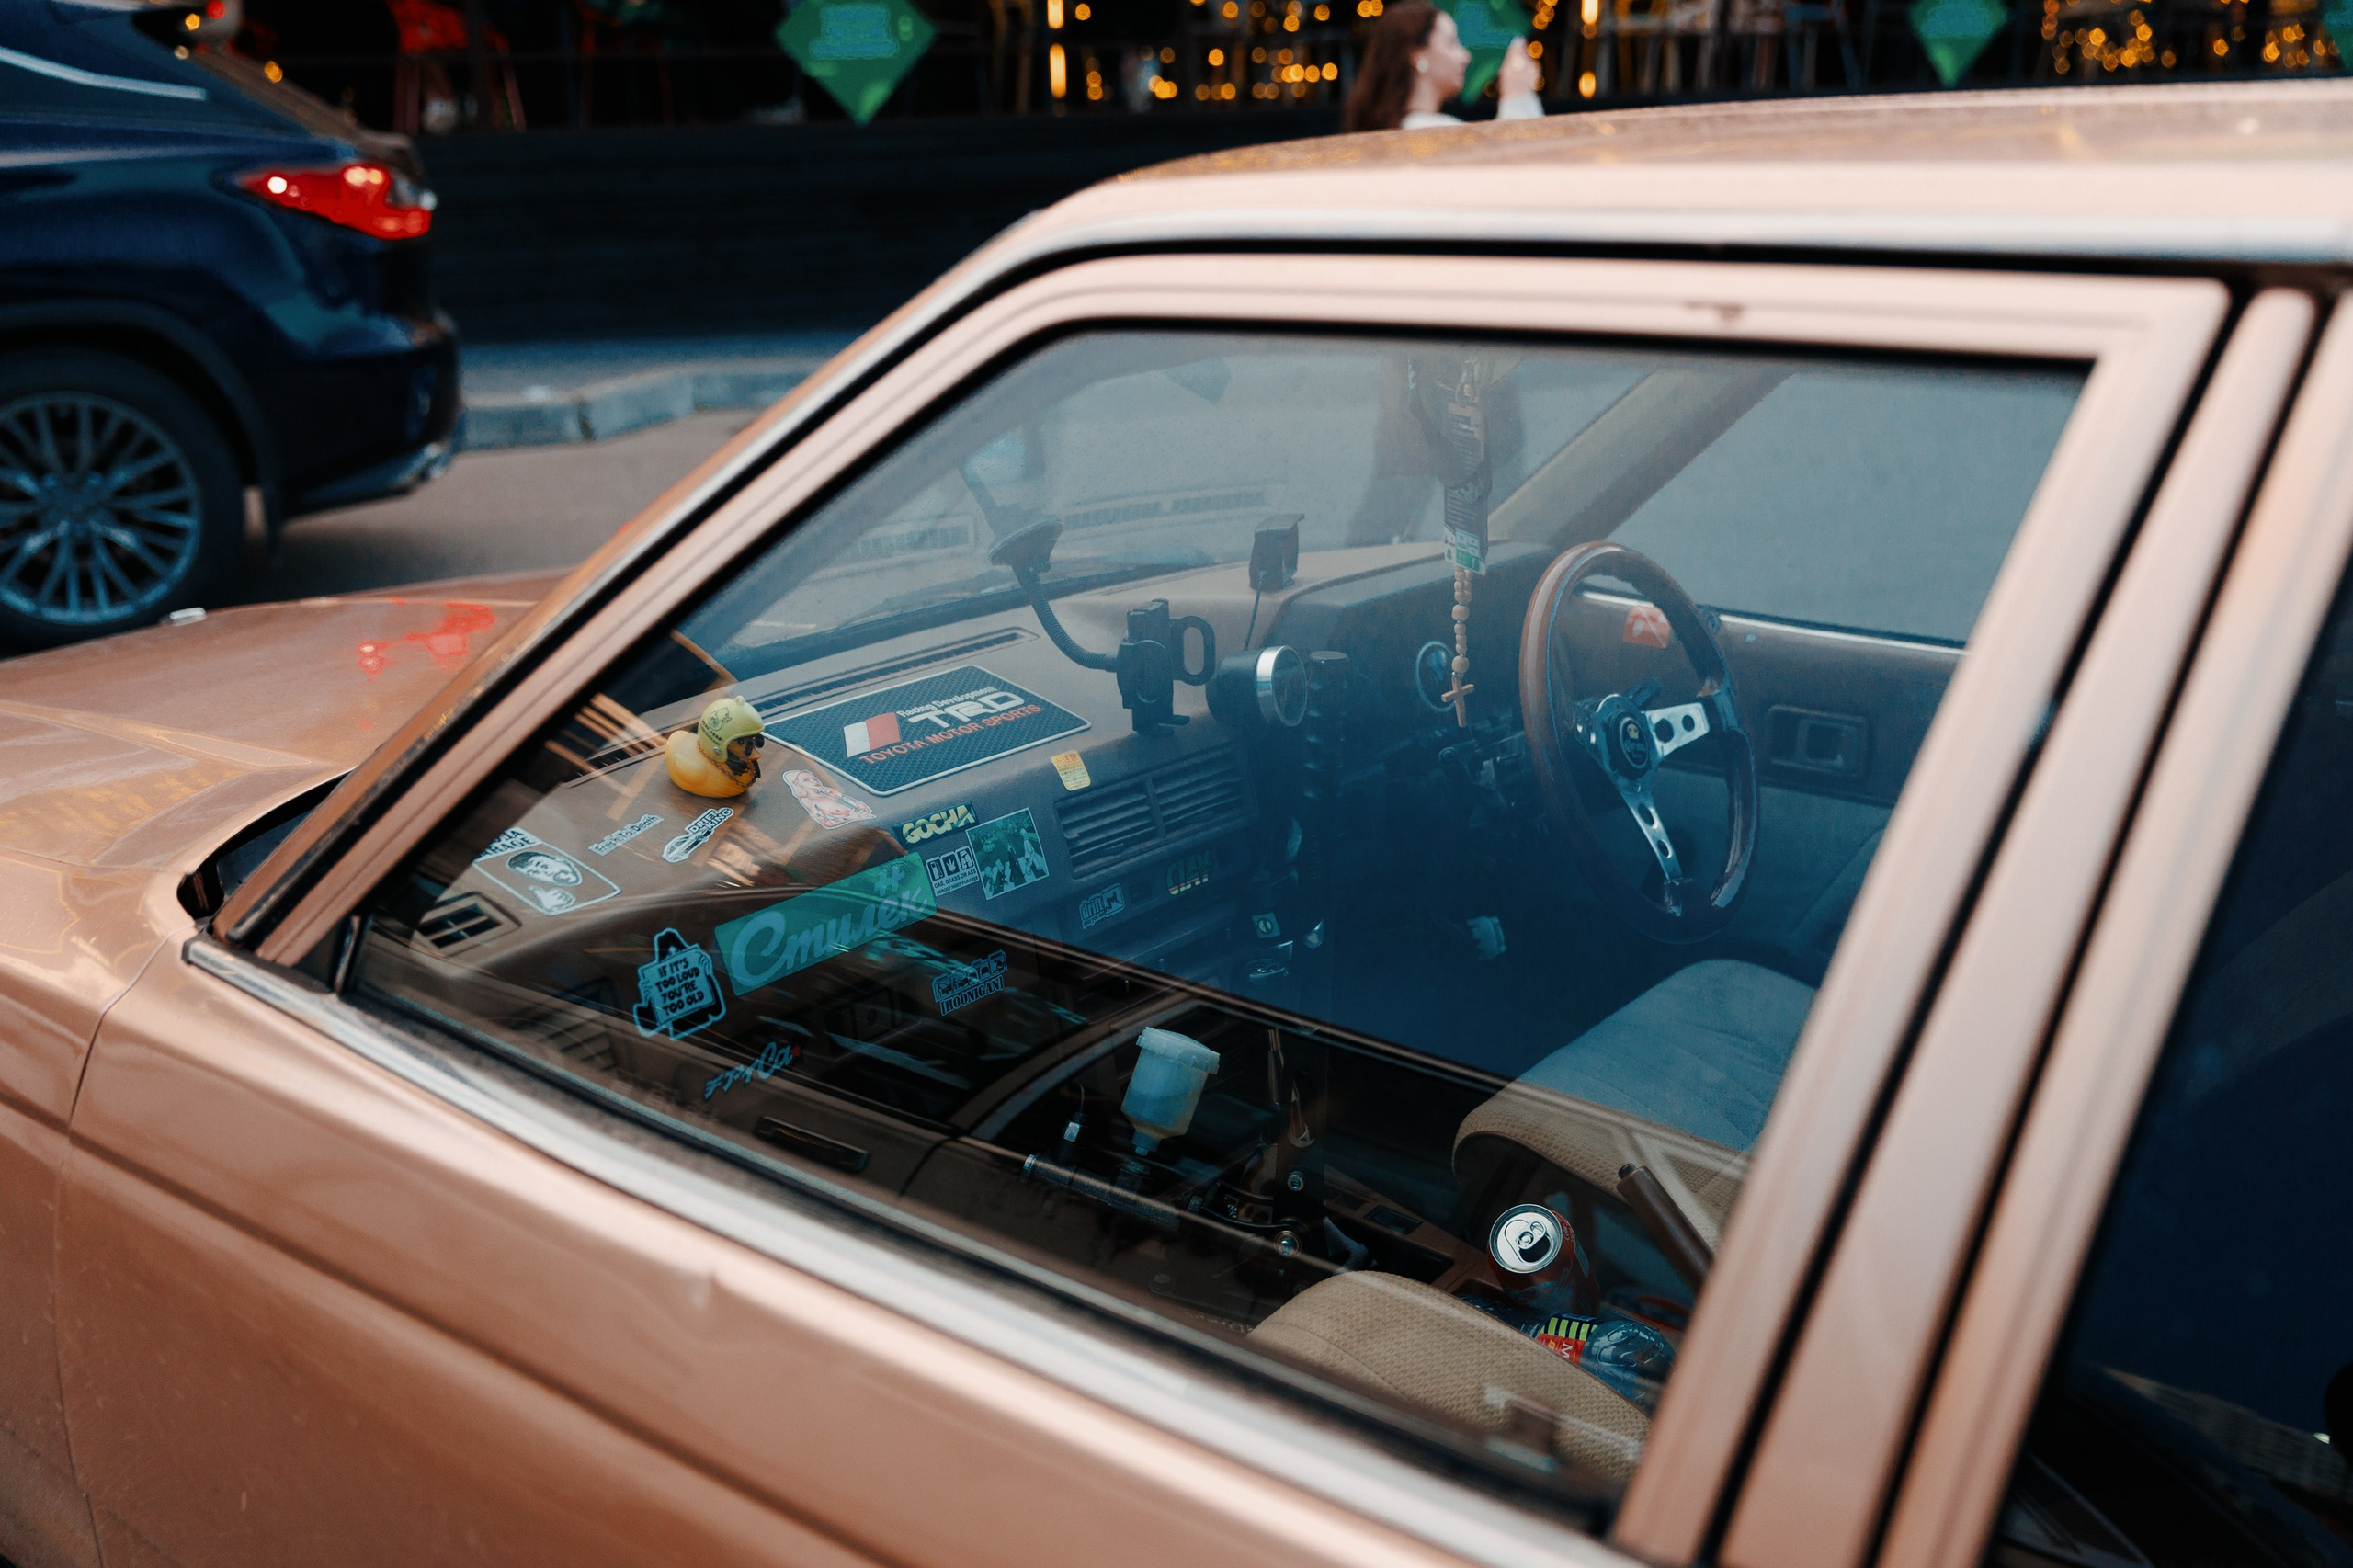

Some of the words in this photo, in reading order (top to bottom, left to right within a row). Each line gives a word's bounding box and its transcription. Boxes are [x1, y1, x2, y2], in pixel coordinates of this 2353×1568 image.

[896, 703, 938, 717] Racing
[907, 691, 1025, 728] TRD
[858, 738, 929, 765] TOYOTA
[926, 722, 984, 744] MOTOR
[982, 704, 1042, 727] SPORTS
[689, 810, 717, 833] DRIFT
[707, 809, 733, 830] KING
[902, 804, 976, 844] GOCHA
[658, 964, 667, 978] IF
[670, 957, 689, 973] IT'S
[655, 977, 676, 992] TOO
[677, 967, 700, 983] LOUD
[661, 980, 698, 1002] YOU'RE
[663, 999, 685, 1015] TOO
[686, 991, 704, 1006] OLD
